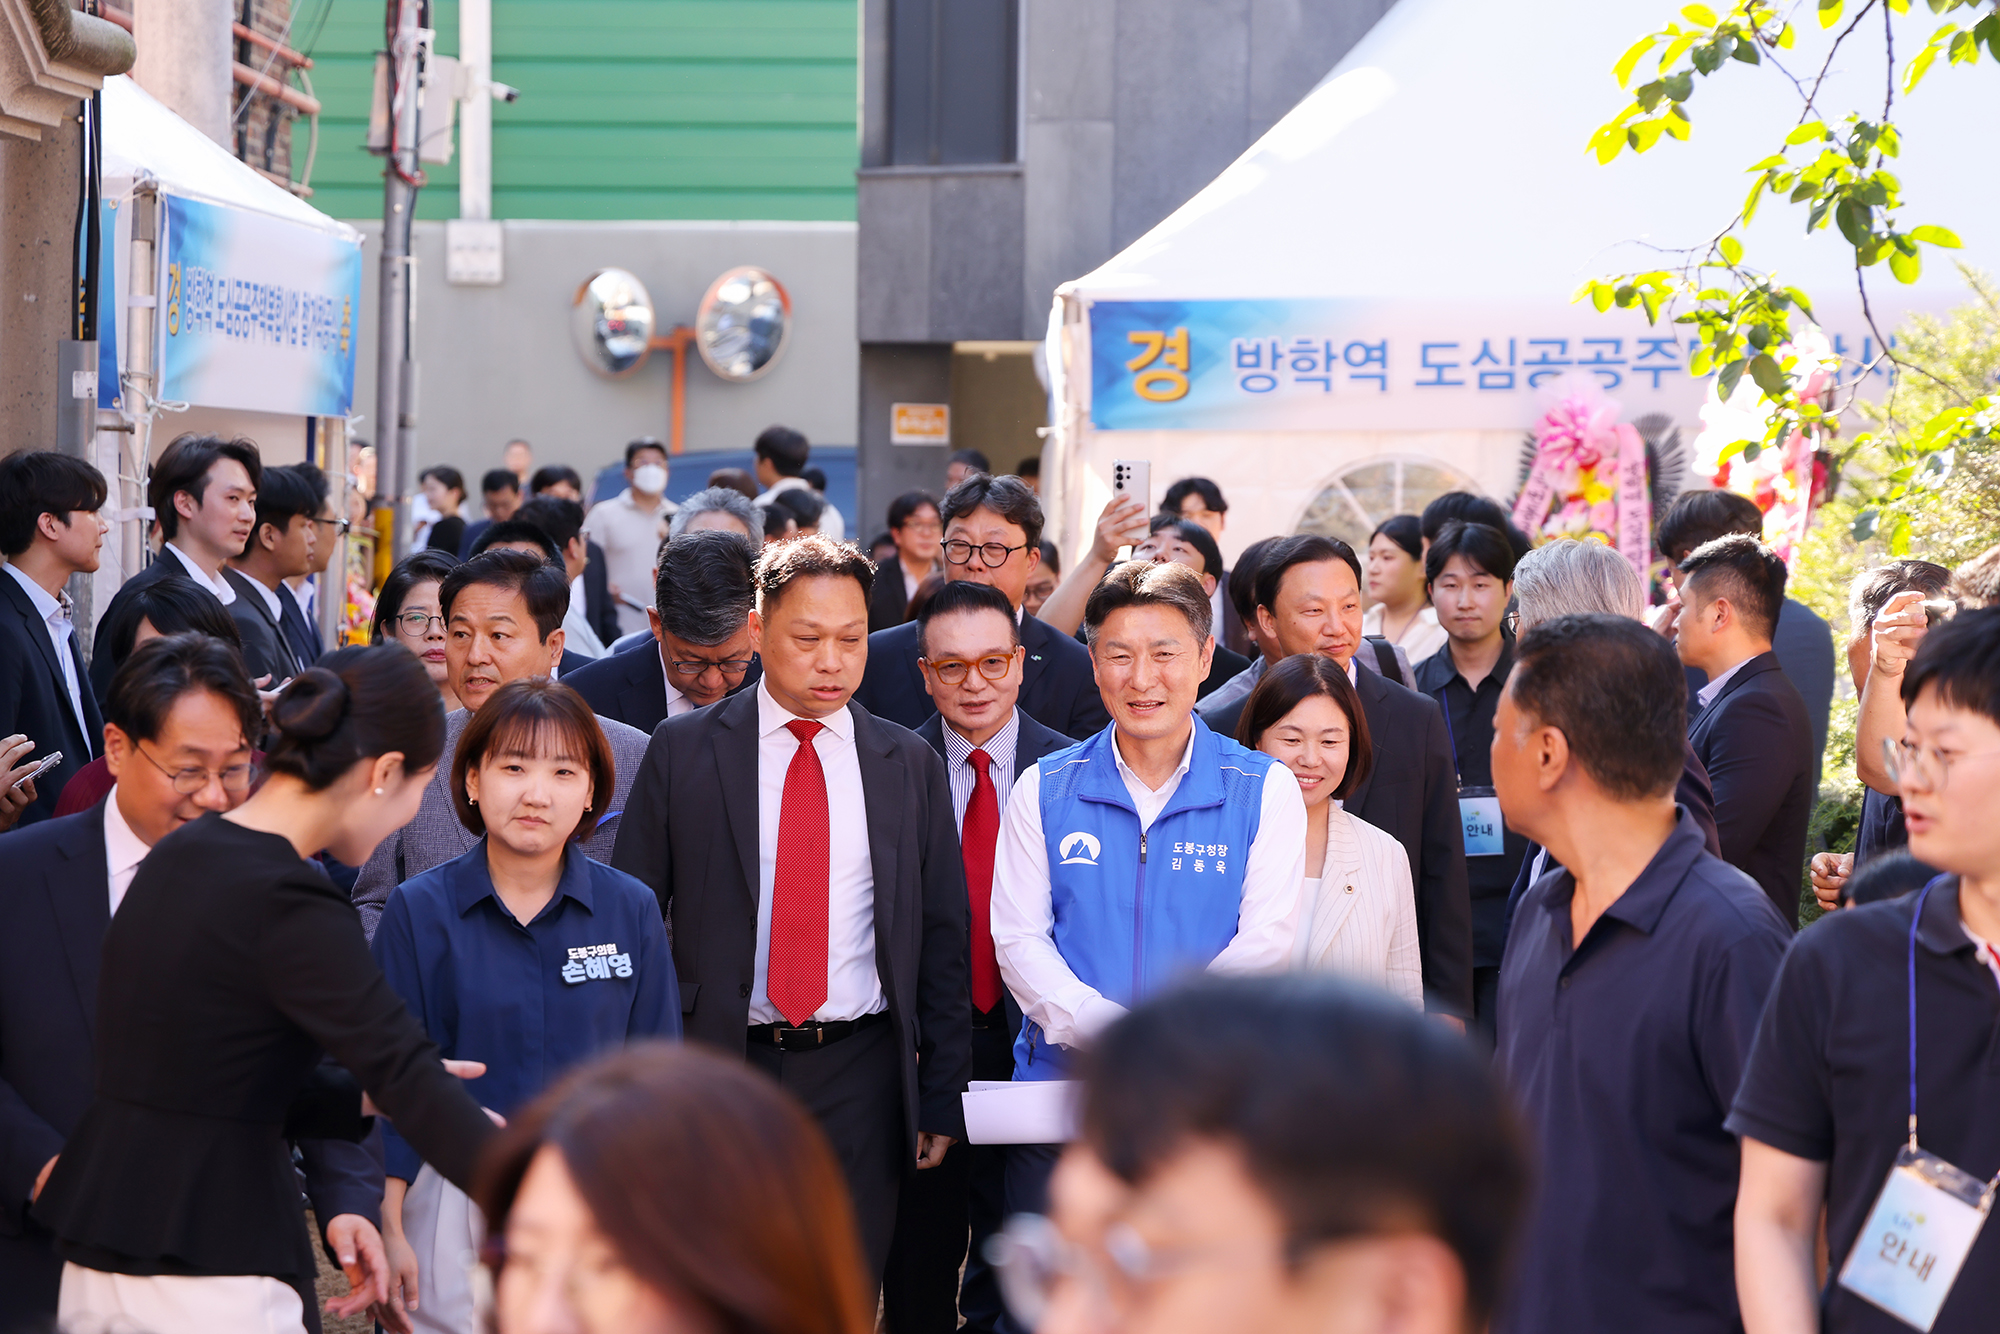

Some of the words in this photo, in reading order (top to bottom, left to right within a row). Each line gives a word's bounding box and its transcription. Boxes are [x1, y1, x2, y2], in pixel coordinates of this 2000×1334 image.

[168, 261, 181, 336] 경
[185, 267, 215, 333] 방학역
[215, 278, 300, 345] 도심공공주택복합사업
[340, 294, 351, 359] 축
[1126, 328, 1190, 402] 경
[1233, 336, 1389, 394] 방학역
[1466, 823, 1494, 838] 안내
[1172, 841, 1229, 857] 도봉구청장
[567, 943, 618, 960] 도봉구의원
[561, 952, 634, 984] 손혜영
[1879, 1231, 1938, 1283] 안내
